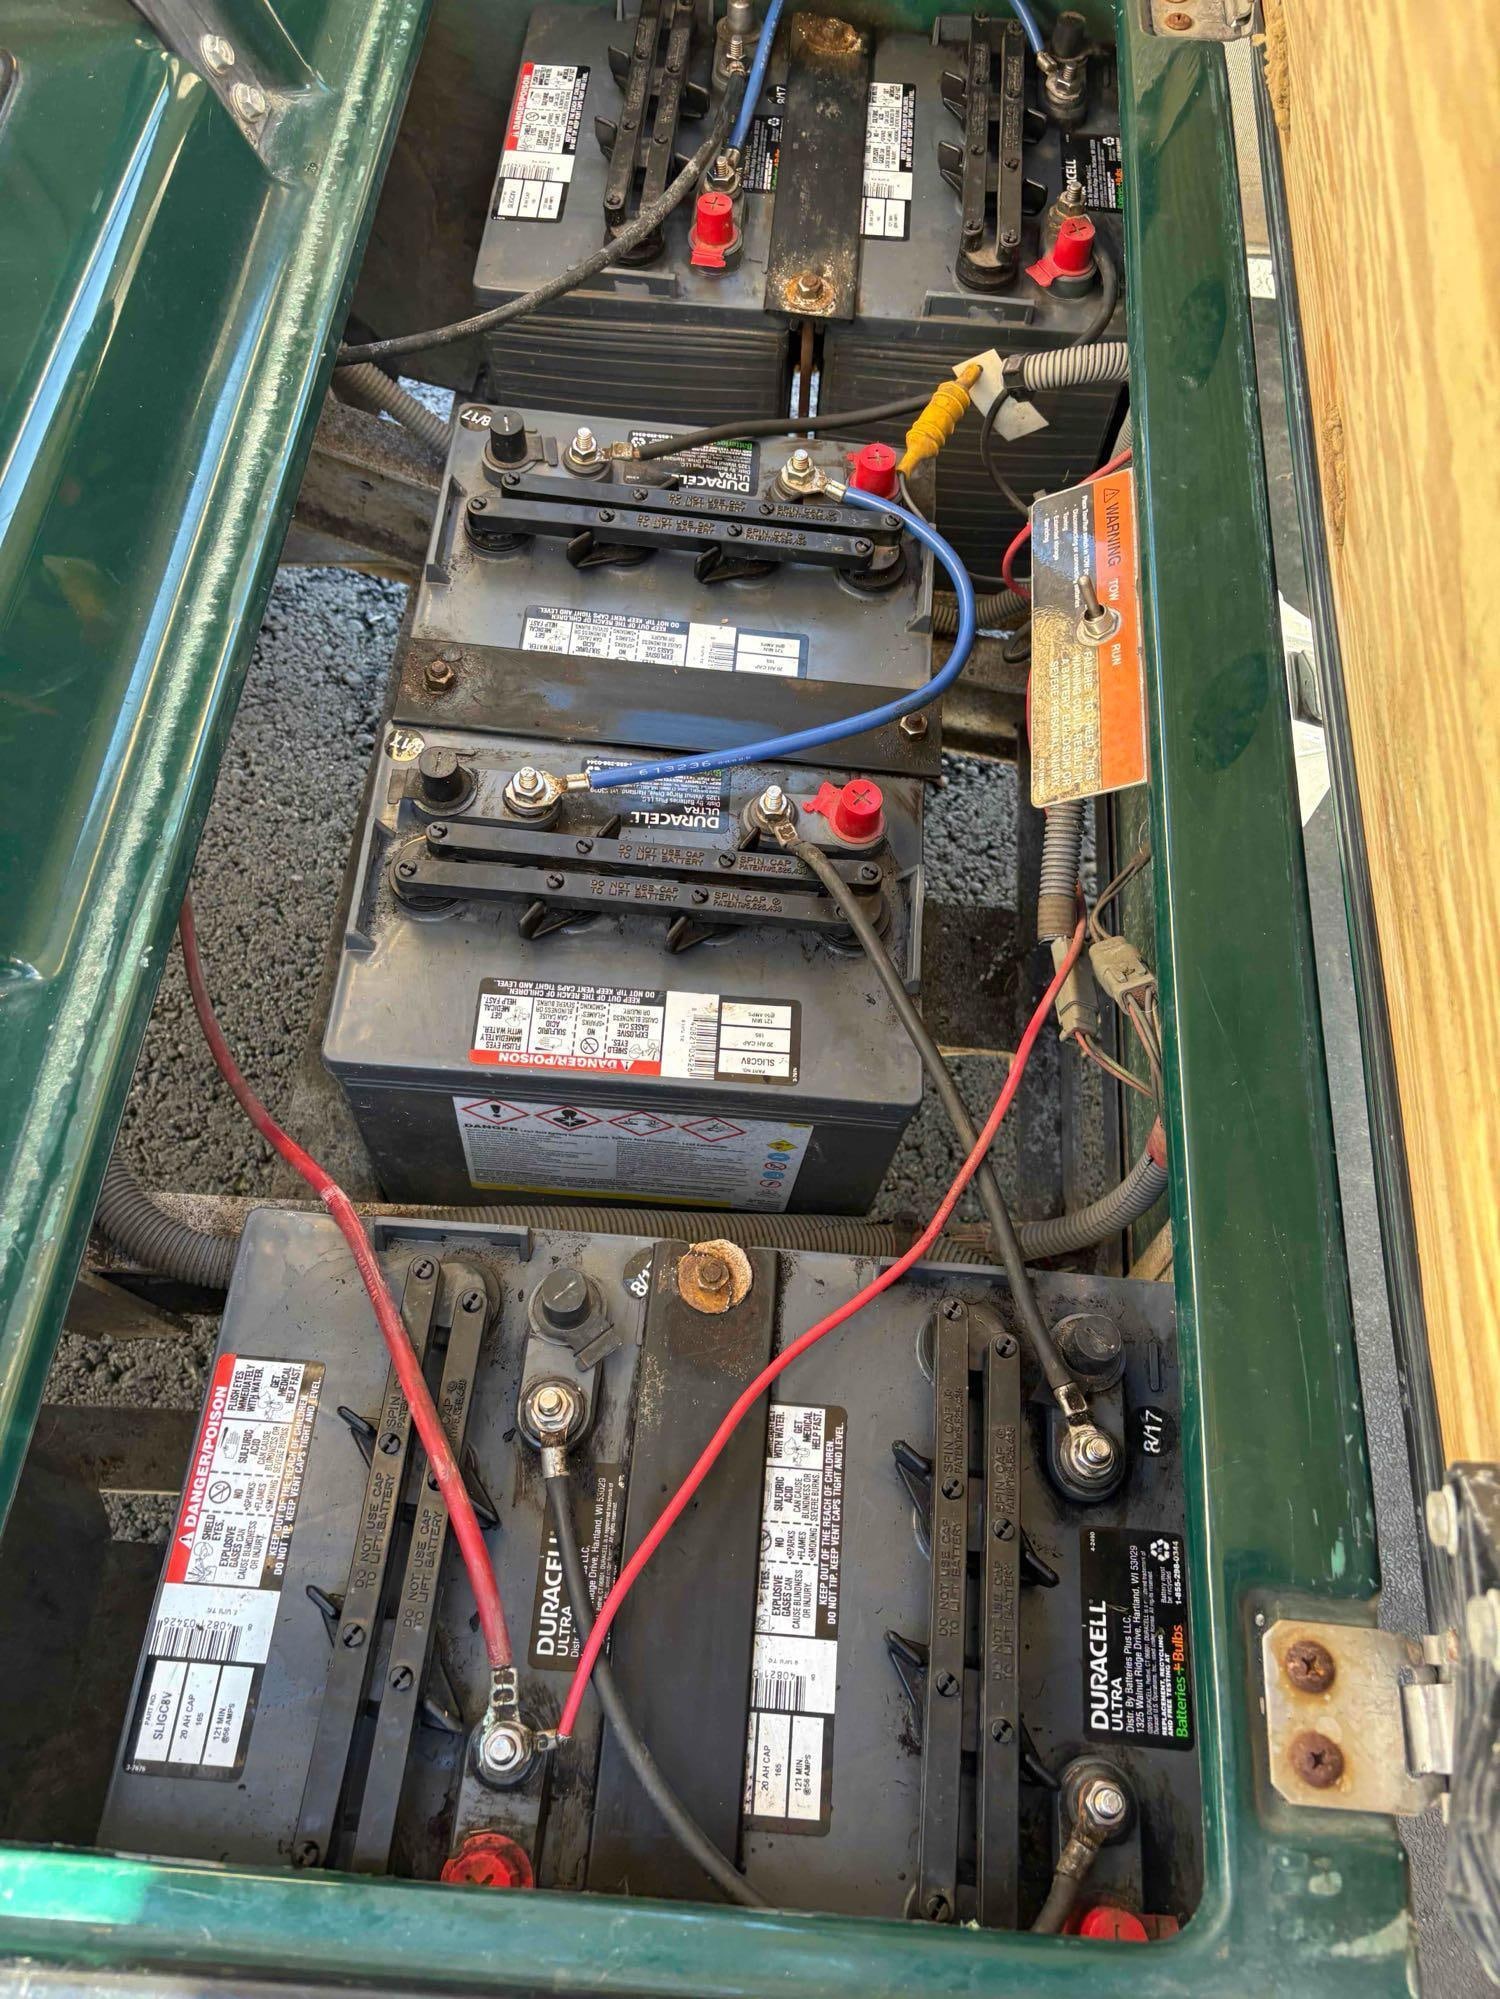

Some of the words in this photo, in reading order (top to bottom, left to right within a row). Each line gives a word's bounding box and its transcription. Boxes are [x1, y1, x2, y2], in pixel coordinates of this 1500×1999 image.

[461, 410, 492, 426] 8/17
[718, 471, 749, 481] ULTRA
[1105, 502, 1121, 568] WARNING
[1108, 578, 1119, 602] TOW
[1060, 657, 1069, 665] A
[1110, 643, 1120, 666] RUN
[1049, 660, 1058, 698] SEVERE
[1071, 654, 1081, 696] WARNING
[1082, 650, 1092, 689] FAILURE
[1061, 665, 1070, 709] BATTERY
[1072, 697, 1082, 731] COULD
[1084, 699, 1092, 712] TO
[1049, 698, 1059, 750] PERSONAL
[1084, 721, 1093, 748] HEED
[1061, 713, 1071, 769] EXPLOSION
[1072, 732, 1082, 770] RESULT
[1062, 770, 1071, 786] OR
[1073, 771, 1082, 783] IN
[1085, 758, 1094, 781] THIS
[630, 808, 719, 831] DURACELL
[684, 805, 719, 816] ULTRA
[590, 886, 603, 894] TO
[609, 888, 629, 897] LIFT
[634, 890, 677, 902] BATTERY
[610, 880, 629, 889] NOT
[635, 883, 654, 891] USE
[659, 885, 678, 894] CAP
[714, 891, 739, 901] SPIN
[745, 894, 766, 904] CAP
[498, 1051, 616, 1069] DANGER/POISON
[740, 1056, 774, 1066] SLIGC8V
[232, 1370, 244, 1387] EYES
[251, 1366, 264, 1392] WATER.
[270, 1374, 281, 1387] GET
[277, 1365, 292, 1396] MEDICAL
[289, 1365, 302, 1385] FAST.
[237, 1364, 255, 1411] IMMEDIATELY
[285, 1386, 297, 1403] HELP
[227, 1389, 240, 1410] FLUSH
[246, 1394, 258, 1412] WITH
[304, 1405, 315, 1422] AND
[260, 1430, 271, 1450] CAUSE
[290, 1436, 300, 1448] OF
[299, 1424, 311, 1448] TIGHT
[835, 1421, 844, 1449] LEVEL.
[1143, 1410, 1163, 1454] 8/17
[183, 1385, 227, 1527] DANGER/POISON
[237, 1428, 254, 1463] SULFURIC
[249, 1438, 261, 1455] ACID
[264, 1436, 278, 1470] BLINDNESS
[271, 1425, 281, 1435] OR
[257, 1451, 267, 1464] CAN
[272, 1450, 284, 1473] SEVERE
[284, 1449, 297, 1478] REACH
[294, 1450, 306, 1472] CAPS
[824, 1437, 835, 1482] CHILDREN.
[834, 1450, 843, 1469] AND
[232, 1488, 244, 1499] NO
[280, 1480, 291, 1496] THE
[289, 1475, 301, 1497] VENT
[371, 1472, 385, 1496] CAP
[823, 1484, 832, 1496] OF
[832, 1470, 842, 1495] TIGHT
[277, 1499, 287, 1511] OF
[284, 1498, 297, 1520] KEEP
[376, 1473, 395, 1529] BATTERY
[832, 1498, 841, 1520] CAPS
[273, 1512, 285, 1531] OUT
[365, 1503, 379, 1529] USE
[822, 1498, 831, 1527] REACH
[201, 1514, 216, 1540] SHIELD
[211, 1518, 225, 1540] EYES.
[235, 1528, 246, 1541] CAN
[242, 1520, 257, 1556] BLINDNESS
[281, 1523, 292, 1539] TIP.
[821, 1528, 830, 1546] THE
[830, 1522, 840, 1545] VENT
[218, 1525, 236, 1566] EXPLOSIVE
[229, 1543, 242, 1567] GASES
[268, 1534, 281, 1555] KEEP
[277, 1540, 288, 1559] NOT
[359, 1535, 373, 1560] NOT
[369, 1535, 383, 1563] LIFT
[820, 1548, 829, 1560] OF
[249, 1559, 258, 1569] OR
[829, 1547, 839, 1569] KEEP
[1129, 1544, 1138, 1570] 53029
[237, 1558, 249, 1579] CAUSE
[273, 1562, 284, 1575] DO
[354, 1569, 367, 1588] DO
[364, 1571, 377, 1588] TO
[819, 1562, 829, 1580] OUT
[828, 1571, 838, 1588] TIP.
[1130, 1572, 1139, 1583] WI
[818, 1582, 828, 1605] KEEP
[828, 1589, 837, 1608] NOT
[827, 1610, 836, 1624] DO
[555, 1604, 573, 1656] ULTRA
[1123, 1635, 1132, 1654] Plus
[1157, 1634, 1165, 1676] RECYCLING
[1088, 1600, 1110, 1729] DURACELL
[1133, 1651, 1144, 1676] Ridge
[1164, 1652, 1170, 1662] AT
[1123, 1656, 1133, 1693] Batteries
[1164, 1664, 1172, 1696] TESTING
[185, 1693, 196, 1712] CAP
[1110, 1676, 1124, 1730] ULTRA
[1124, 1695, 1135, 1707] By
[1135, 1678, 1144, 1709] Walnut
[143, 1705, 154, 1725] PART
[152, 1691, 173, 1740] SLIGC8V
[182, 1714, 191, 1727] AH
[195, 1712, 204, 1725] 165
[224, 1702, 235, 1725] AMPS
[1125, 1710, 1134, 1732] Distr.
[1135, 1711, 1144, 1733] 1325
[179, 1729, 188, 1739] 20
[212, 1726, 222, 1740] 121
